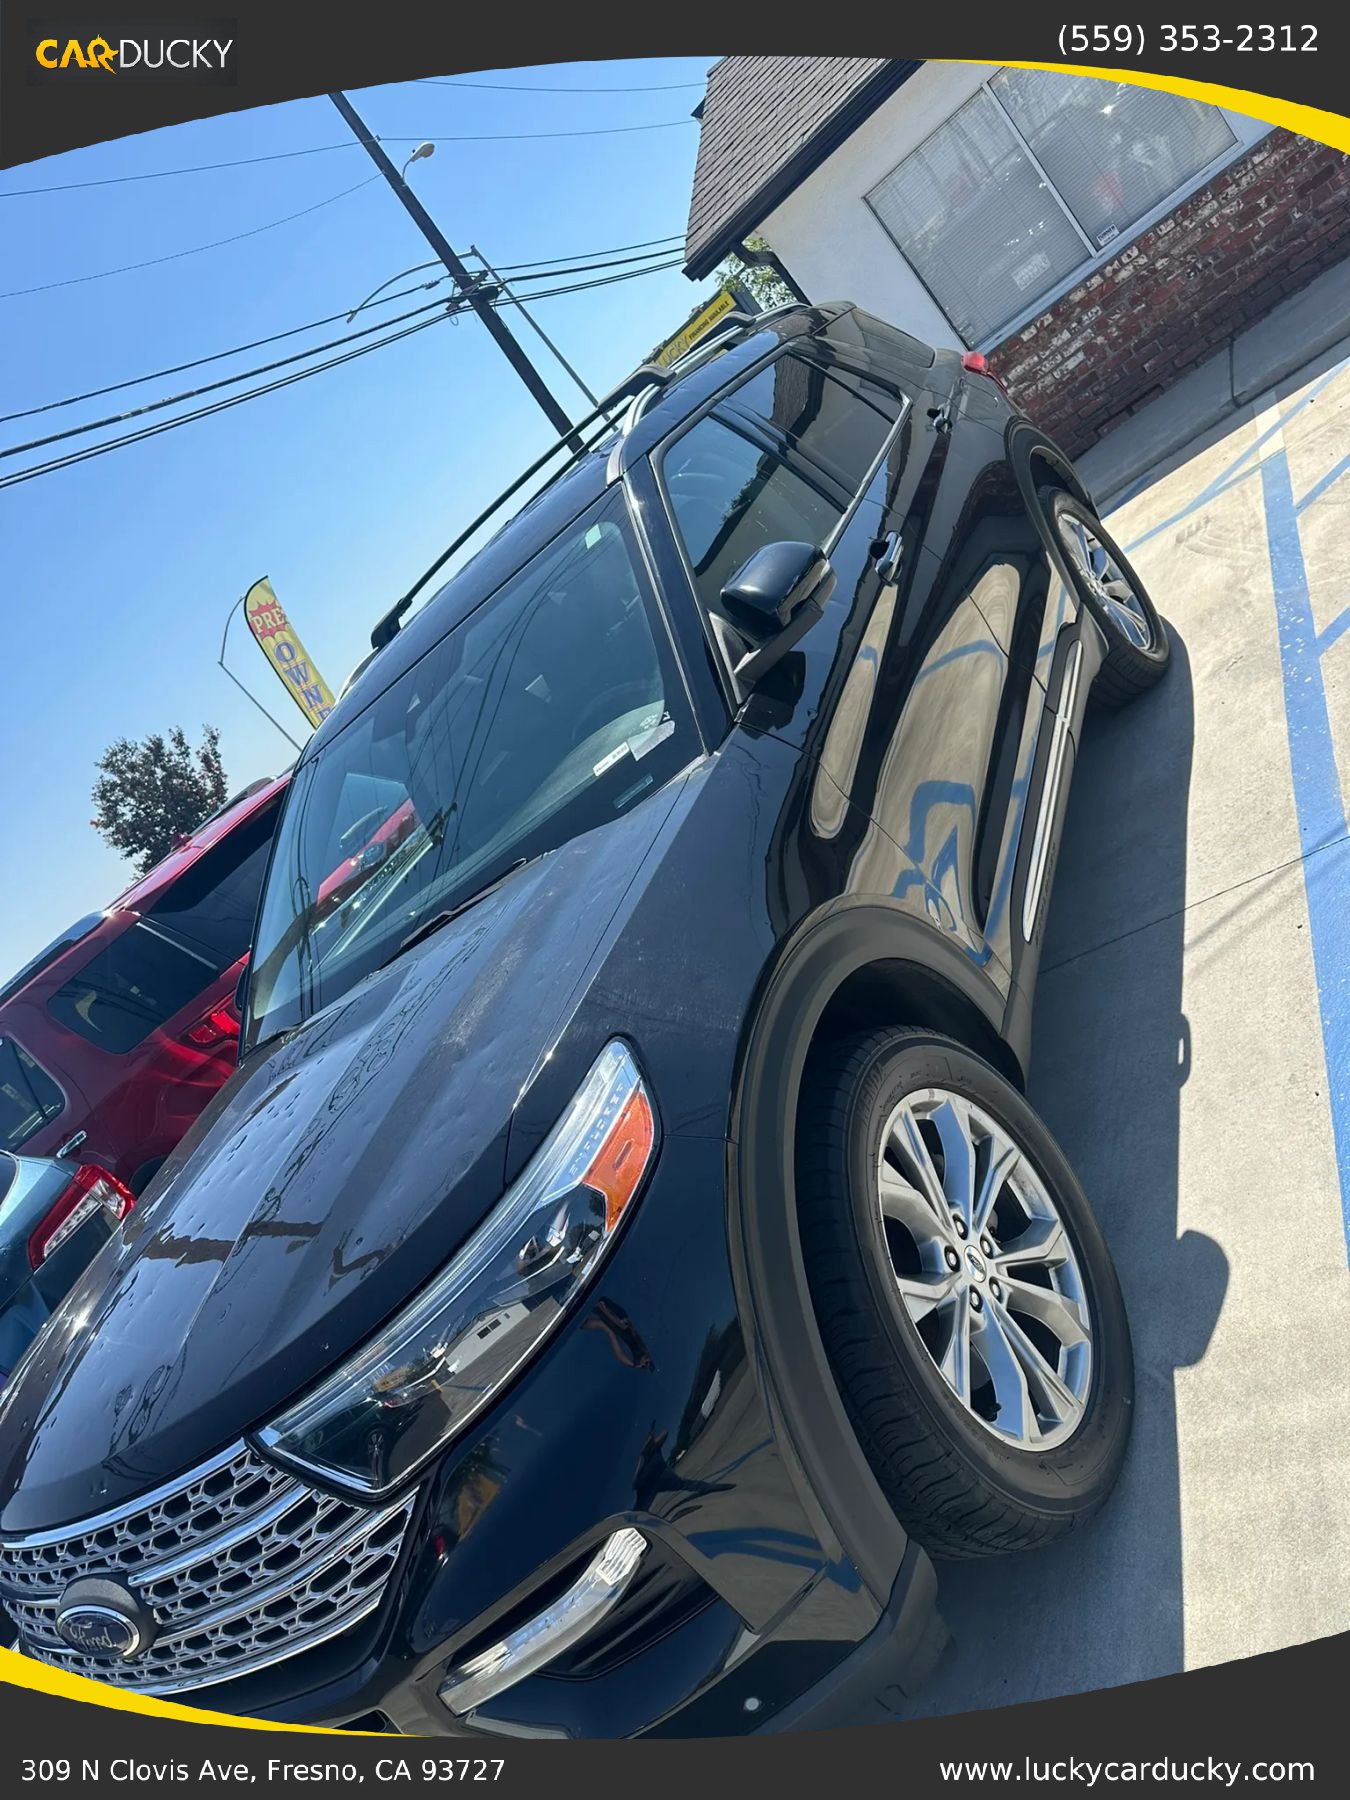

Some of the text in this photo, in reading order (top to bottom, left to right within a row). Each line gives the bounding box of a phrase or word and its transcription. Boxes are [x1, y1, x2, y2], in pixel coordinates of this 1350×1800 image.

[656, 335, 690, 366] UCKY
[252, 607, 285, 633] PRE
[68, 1620, 118, 1652] Ford
